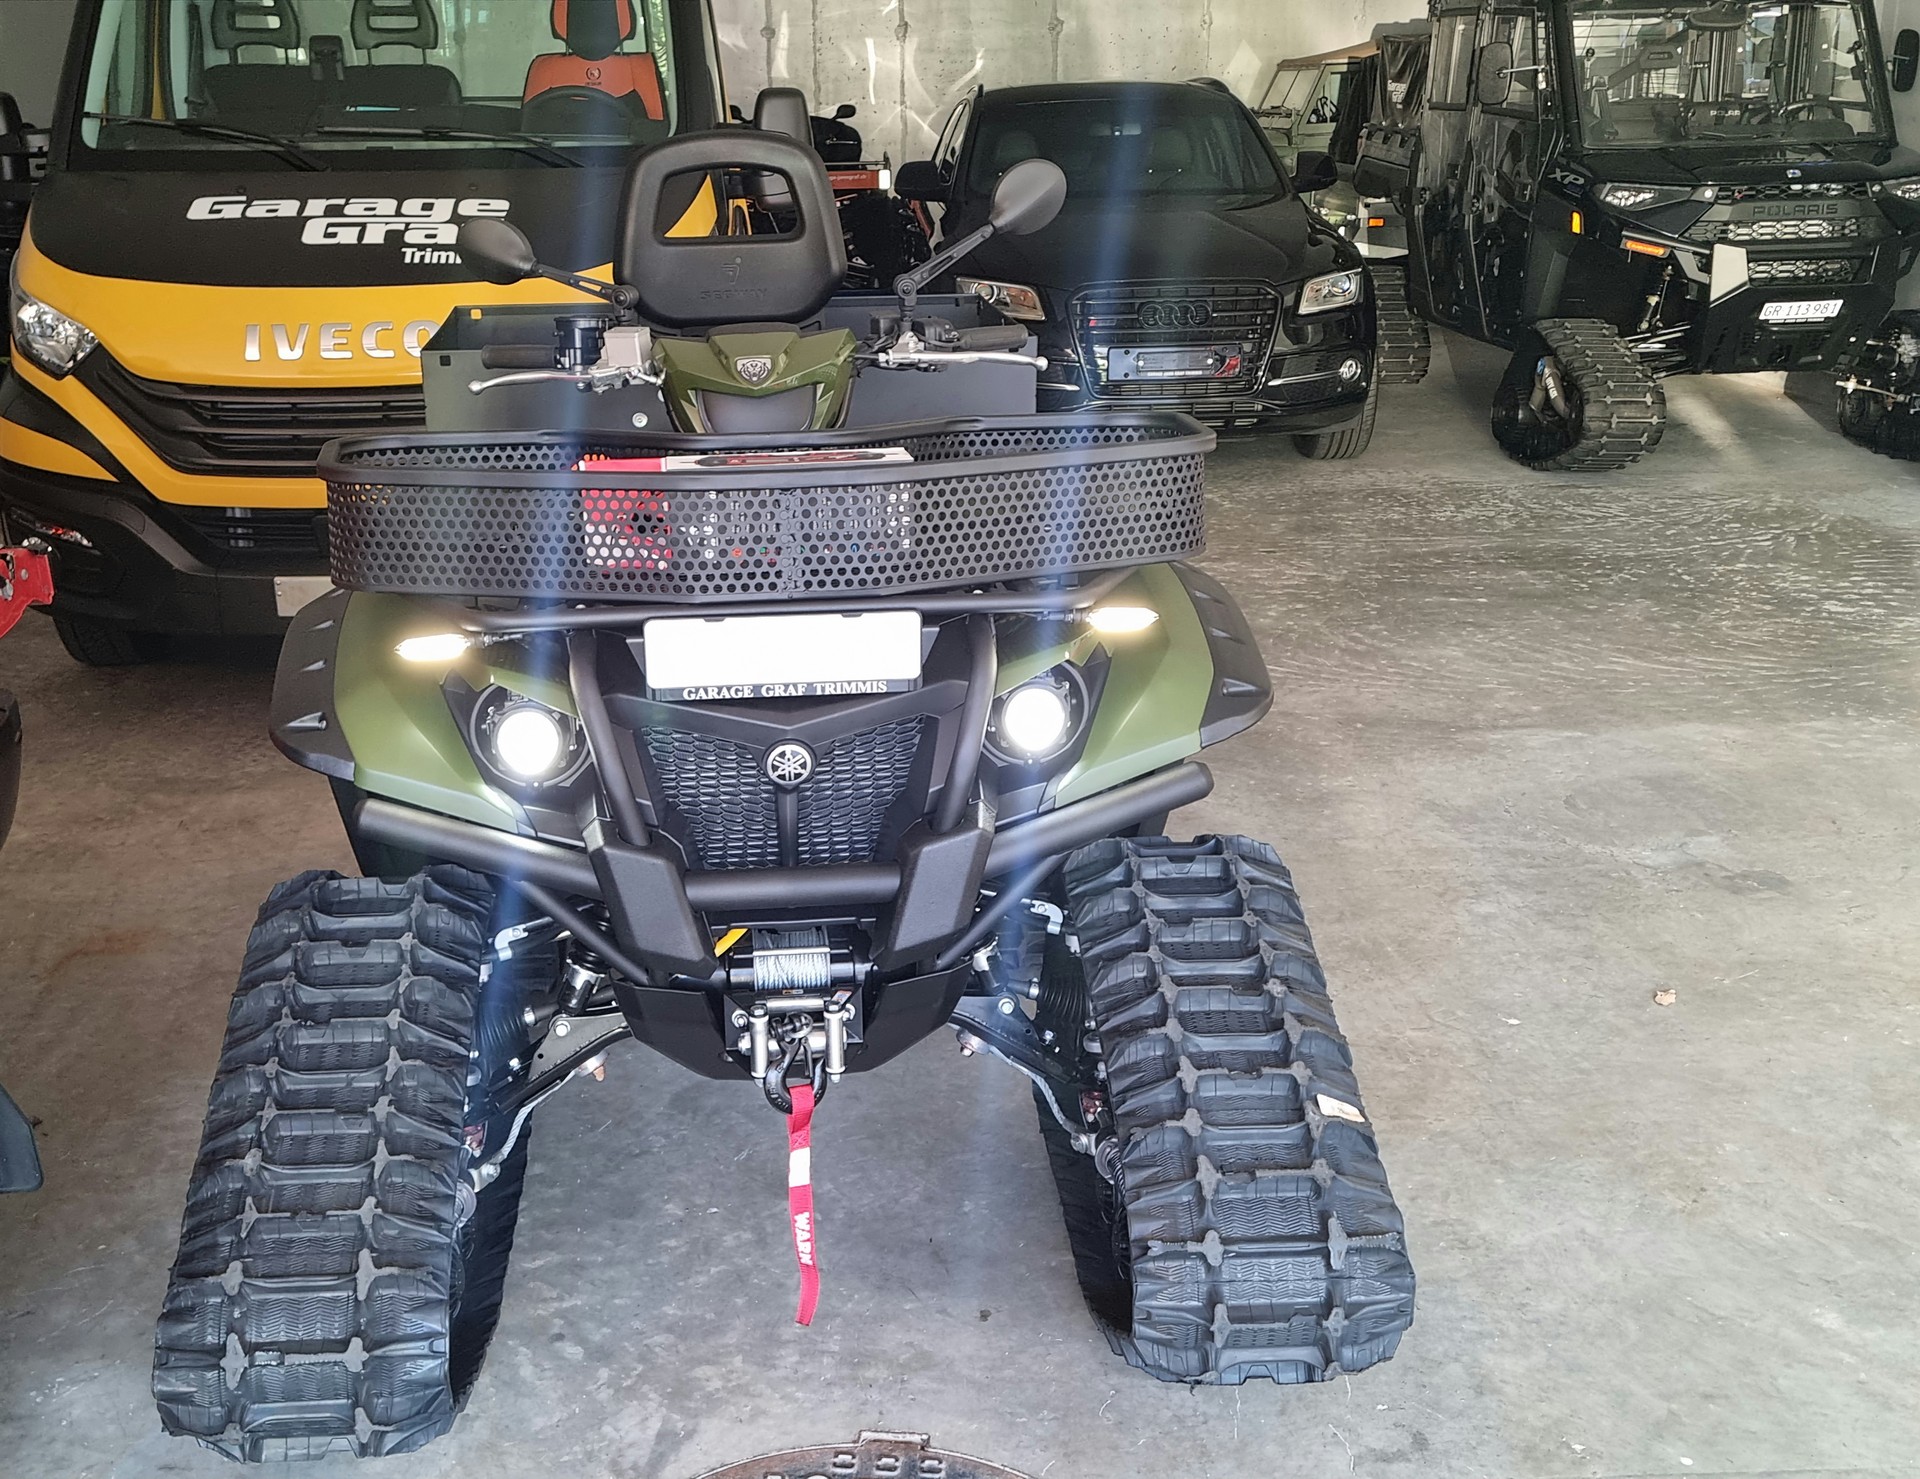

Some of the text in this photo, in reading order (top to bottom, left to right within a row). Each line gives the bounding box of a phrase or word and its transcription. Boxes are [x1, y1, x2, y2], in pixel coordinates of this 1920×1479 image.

[1547, 167, 1585, 185] XP
[185, 195, 511, 223] Garage
[1752, 203, 1839, 217] POLARIS
[301, 216, 461, 245] Gra
[401, 247, 462, 264] Trim
[1785, 302, 1838, 317] 113981
[682, 680, 888, 701] GARAGE GRAF TRIMMIS
[794, 1211, 813, 1266] WARN
